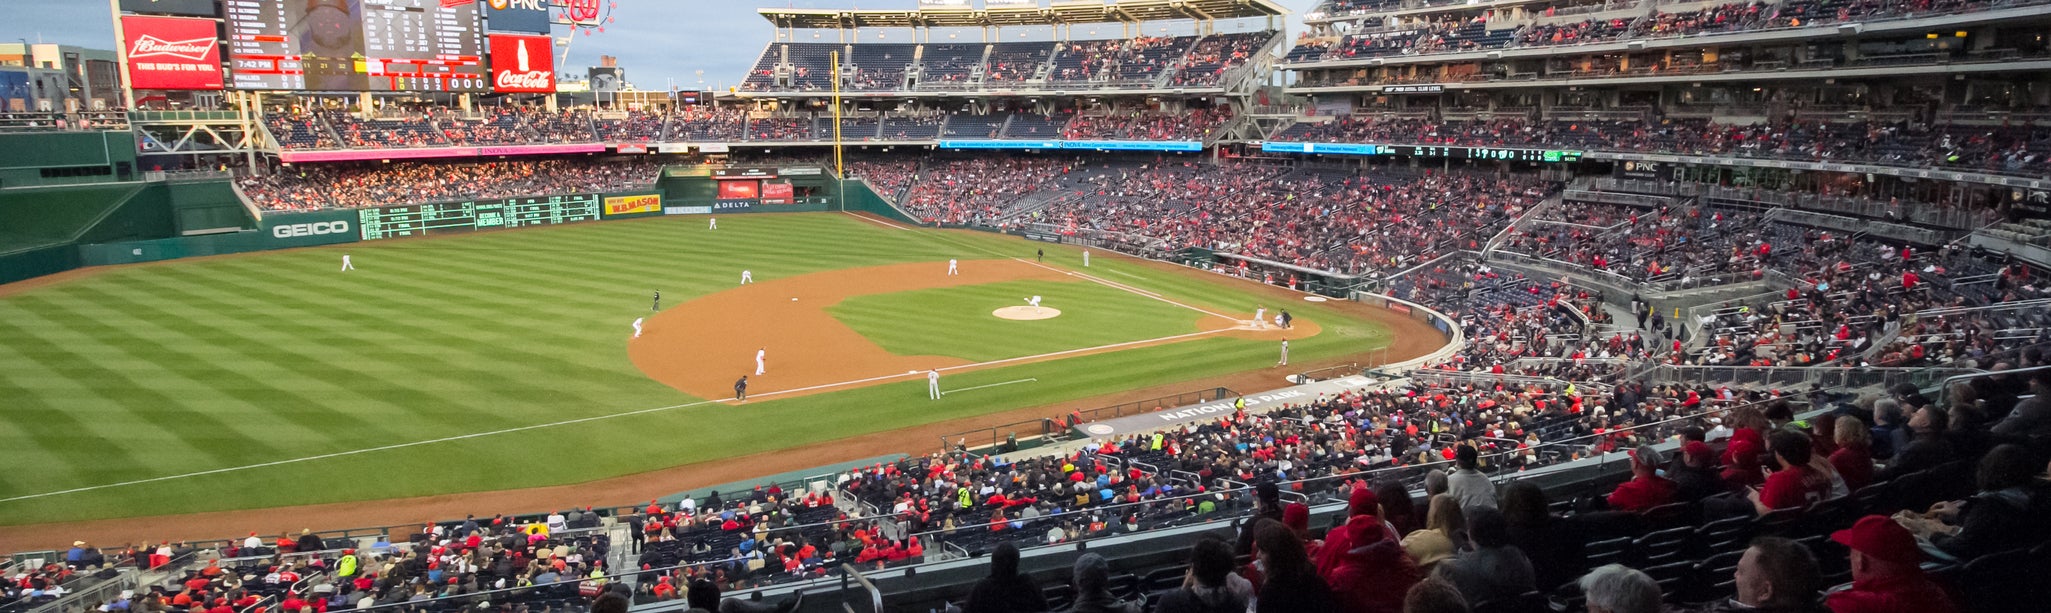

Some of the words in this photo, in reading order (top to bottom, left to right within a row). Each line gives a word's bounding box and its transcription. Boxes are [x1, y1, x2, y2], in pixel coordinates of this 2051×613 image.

[510, 0, 546, 11] PNC
[134, 39, 209, 53] Budweiser
[136, 63, 155, 71] THIS
[156, 63, 180, 71] BUD'S
[197, 64, 215, 72] YOU.
[239, 60, 257, 68] 7:42
[258, 61, 271, 69] PM
[451, 79, 459, 88] 0
[463, 79, 471, 89] 0
[475, 80, 483, 89] 0
[497, 70, 552, 88] Coca-Cola
[1636, 162, 1657, 172] PNC
[477, 217, 504, 227] MEMBER
[273, 220, 349, 239] GEICO
[1258, 389, 1307, 403] PARK
